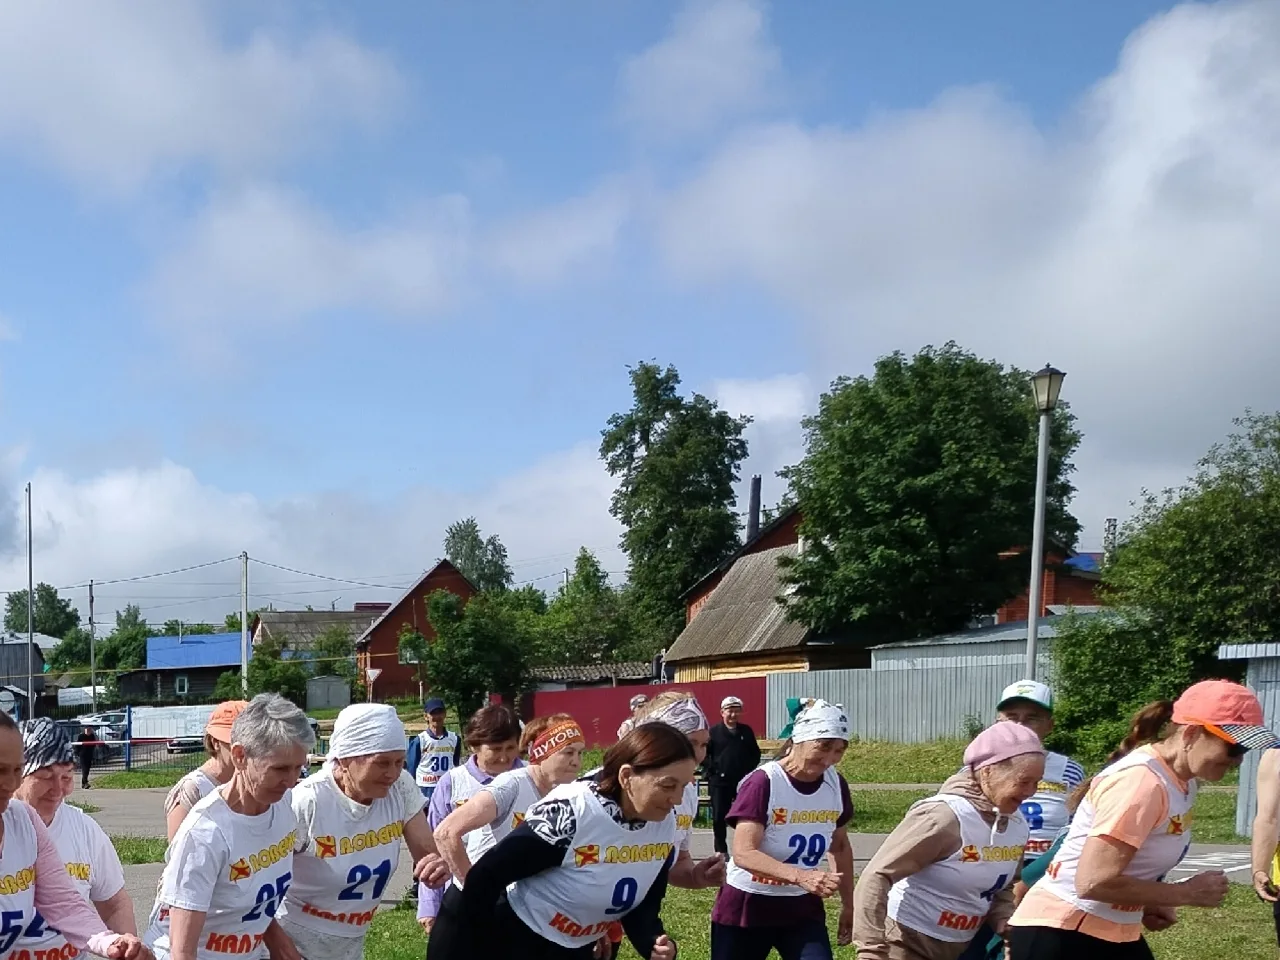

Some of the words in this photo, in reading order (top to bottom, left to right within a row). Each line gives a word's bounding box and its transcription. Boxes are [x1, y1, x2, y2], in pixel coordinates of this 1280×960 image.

[431, 756, 449, 772] 30
[340, 820, 405, 855] ДОВЕРИ
[604, 843, 674, 864] ДОВЕРИ
[782, 833, 826, 867] 29
[242, 871, 292, 923] 25
[338, 859, 391, 900] 21
[605, 877, 638, 915] 9
